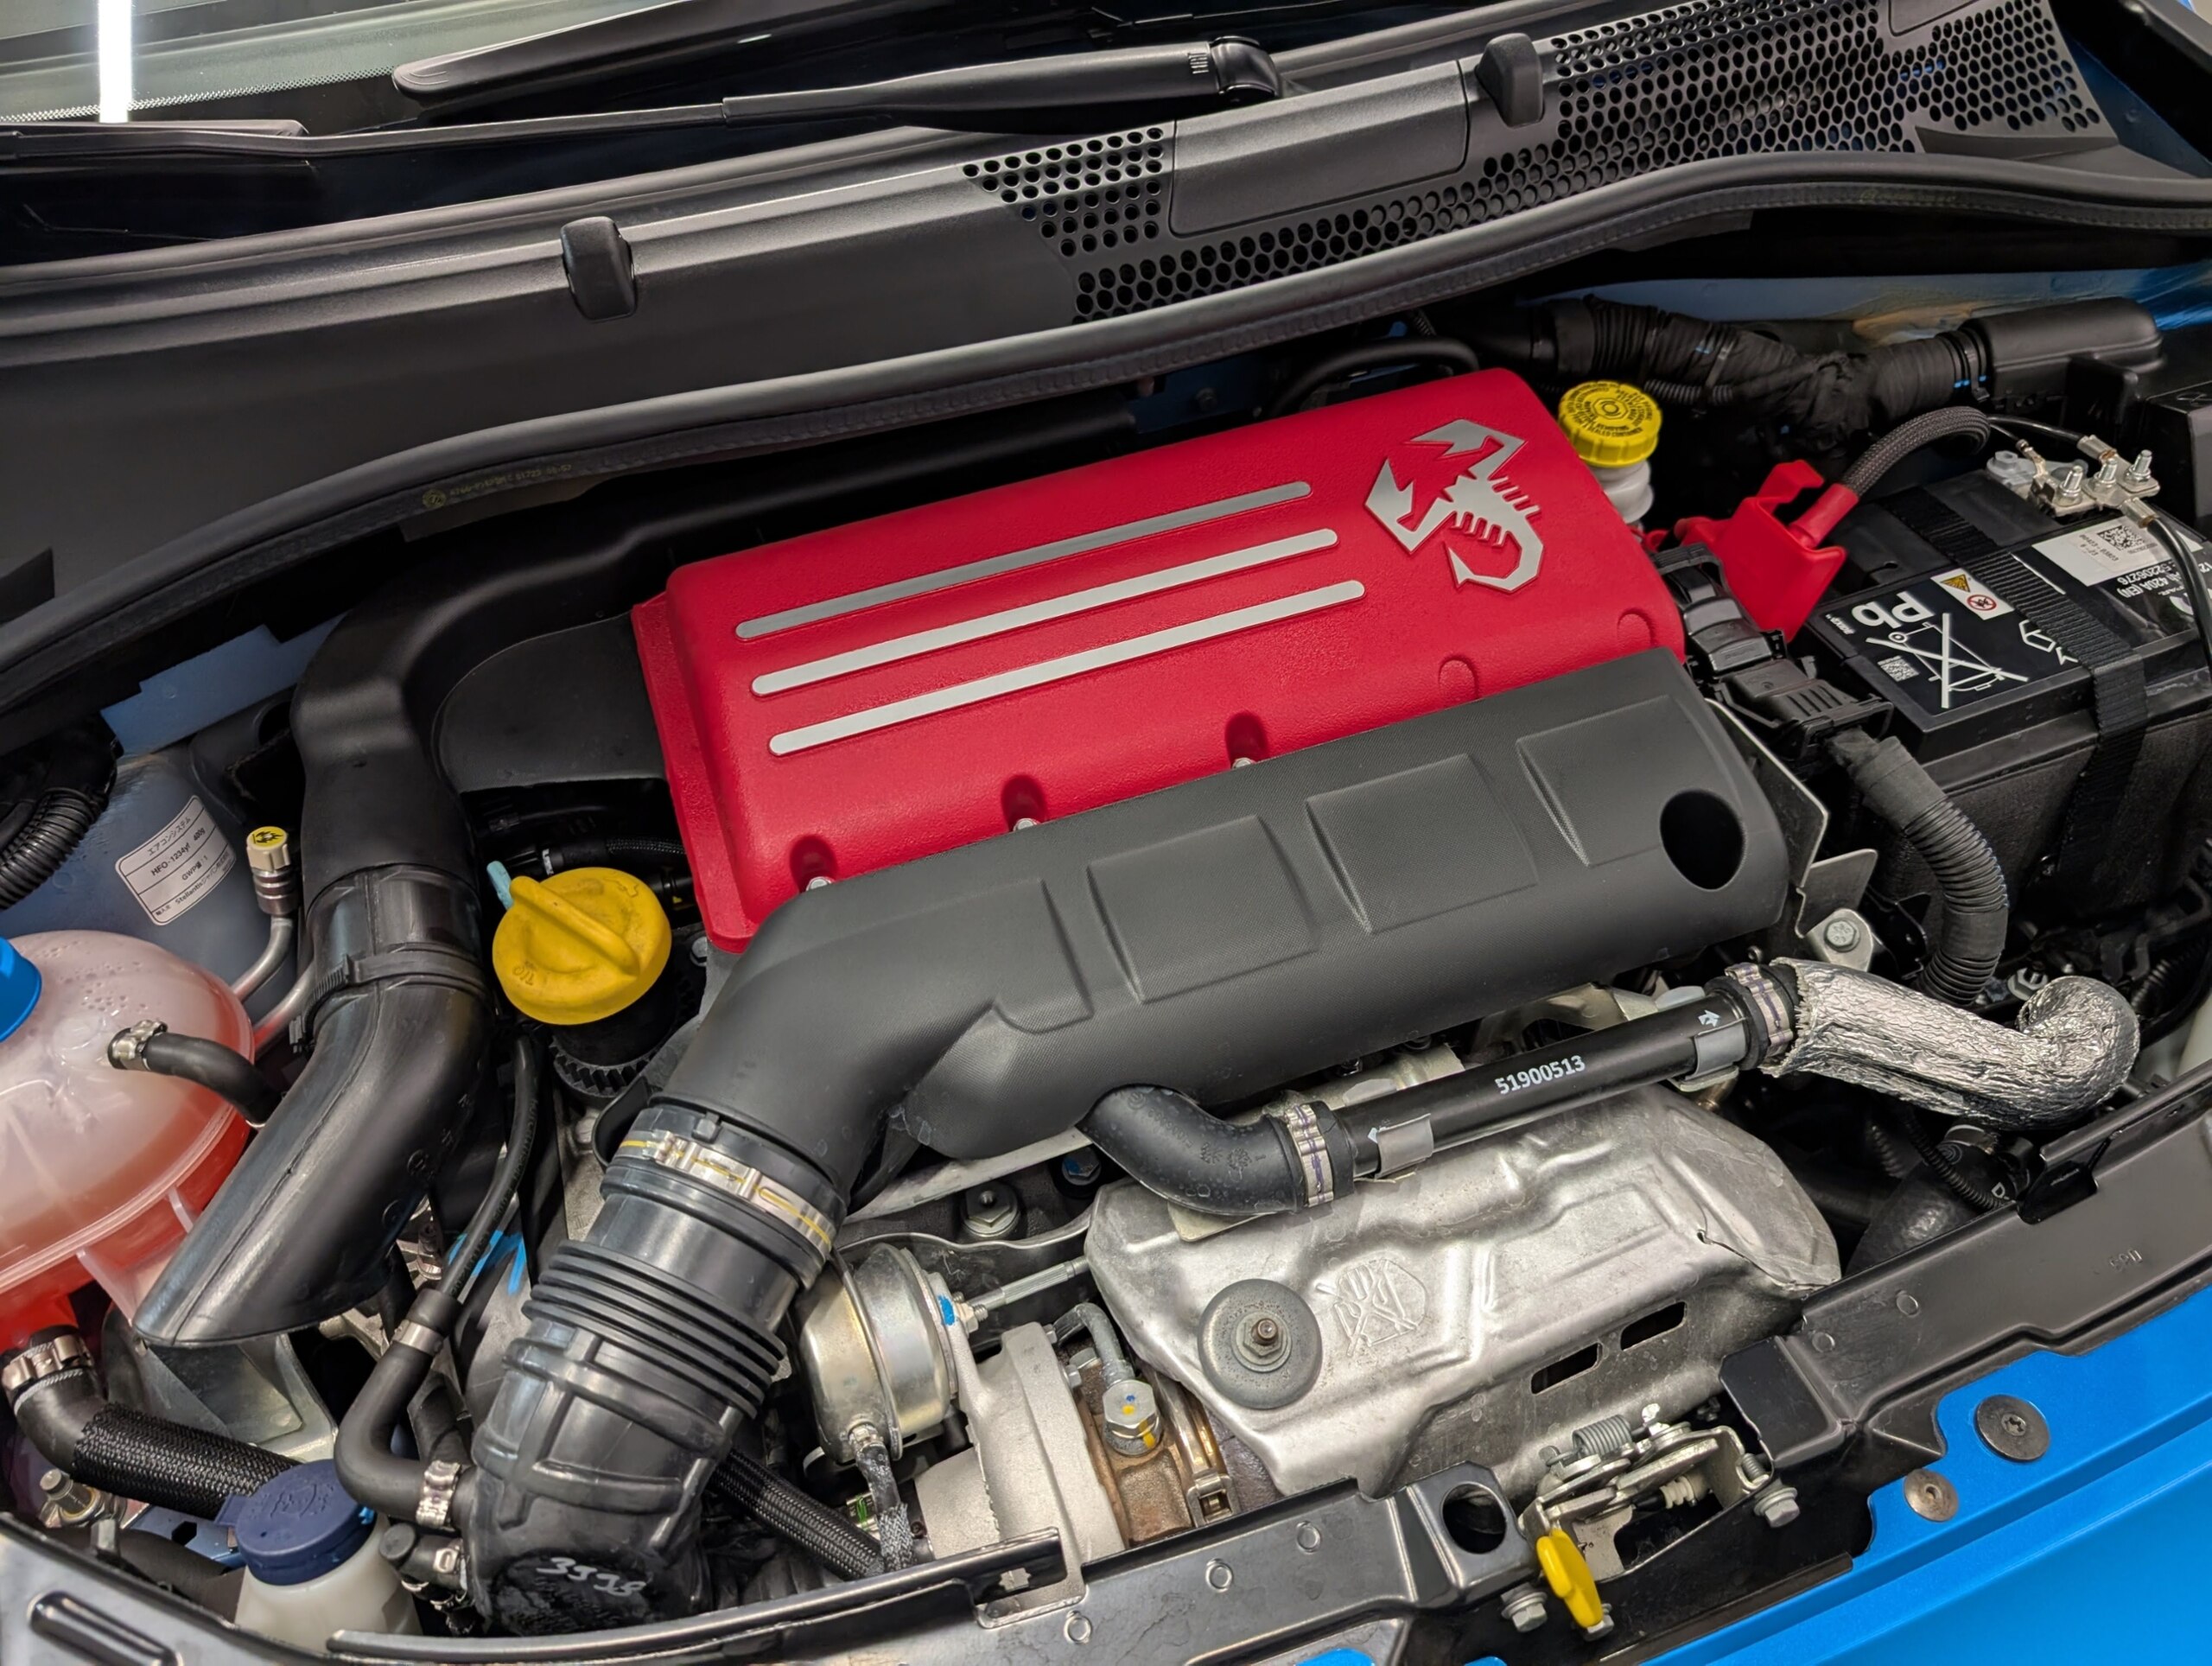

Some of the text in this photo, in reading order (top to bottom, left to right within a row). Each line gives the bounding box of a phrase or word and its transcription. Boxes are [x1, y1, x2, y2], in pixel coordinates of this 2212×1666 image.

[2117, 563, 2171, 585] 52206276
[2139, 577, 2169, 590] 420A
[1852, 591, 1936, 629] Pb
[147, 816, 192, 855] エアコンシステム
[1494, 1054, 1586, 1095] 51900513
